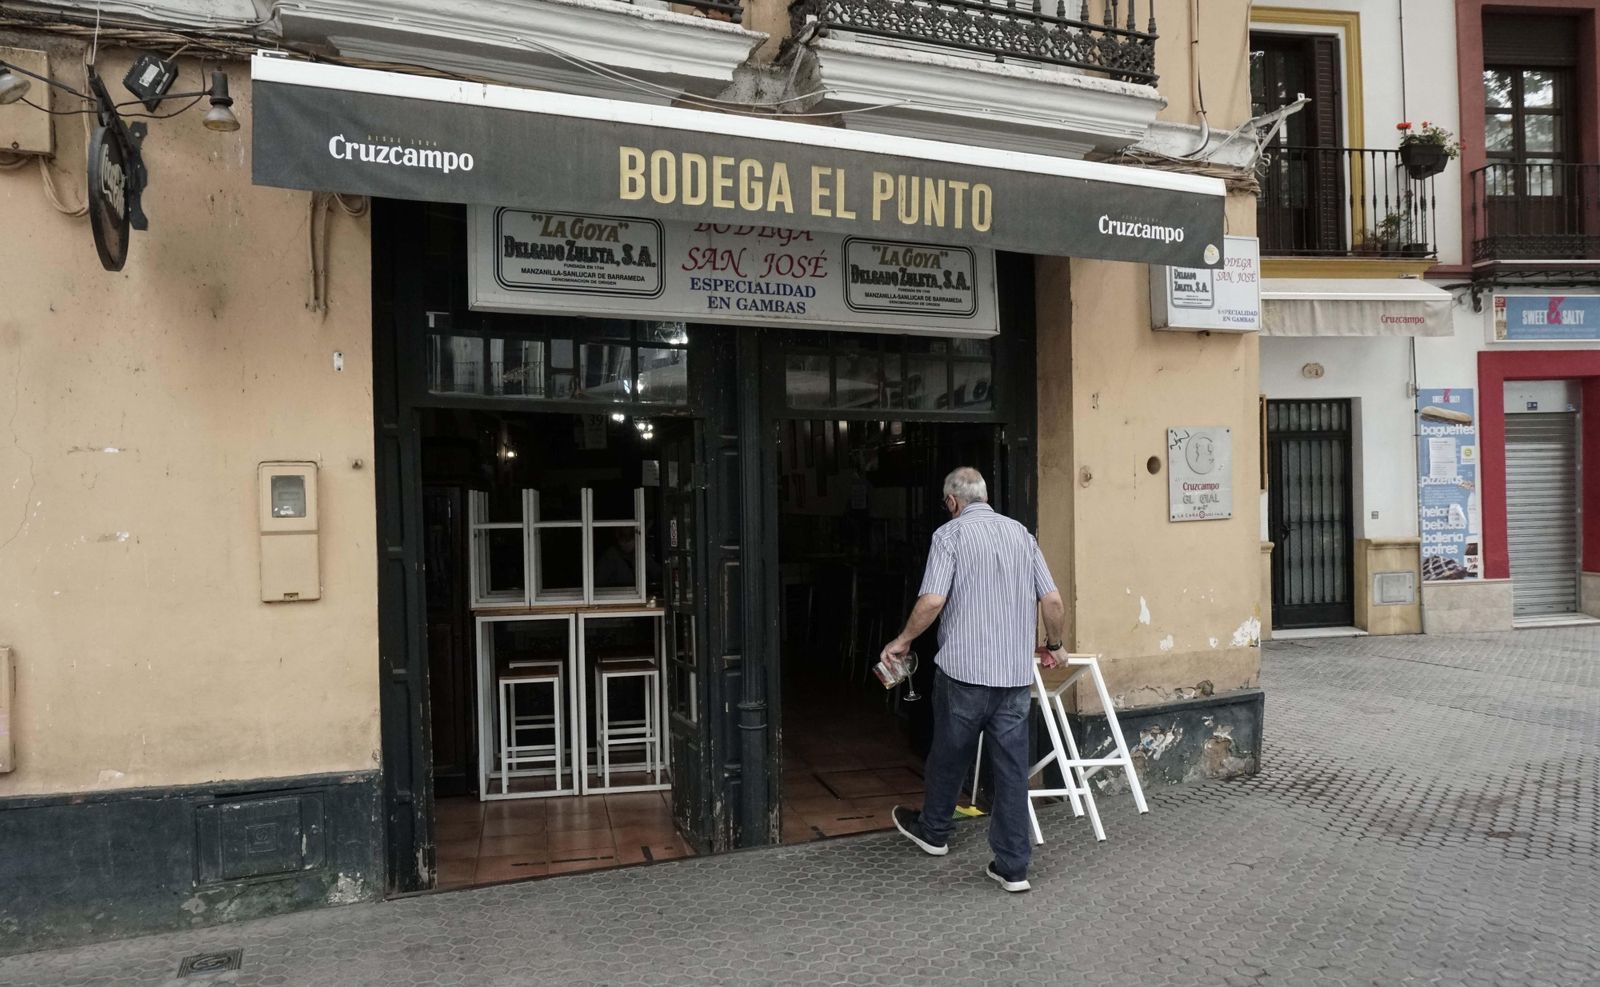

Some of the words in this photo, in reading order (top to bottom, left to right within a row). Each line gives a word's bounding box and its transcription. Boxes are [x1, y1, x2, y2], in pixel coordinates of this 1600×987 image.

[328, 134, 474, 174] Cruzcampo
[620, 146, 794, 215] BODEGA
[810, 166, 856, 220] EL
[872, 171, 993, 232] PUNTO
[1098, 214, 1184, 244] Cruzcampo
[504, 235, 565, 261] DELGADO
[622, 243, 657, 268] S.A.
[682, 247, 748, 278] SAN
[760, 250, 828, 278] JOSÉ
[1224, 257, 1252, 271] ODEGA
[608, 274, 646, 282] BARRAMEDA
[942, 270, 970, 290] S.A.
[690, 277, 816, 298] ESPECIALIDAD
[707, 296, 731, 310] EN
[736, 298, 806, 314] GAMBAS
[1380, 314, 1424, 324] Cruzcampo
[1522, 310, 1548, 325] SWEET
[1562, 310, 1584, 325] SALTY
[1420, 424, 1474, 437] baguettes
[1182, 482, 1220, 491] Cruzcampo
[1422, 544, 1458, 558] gofres
